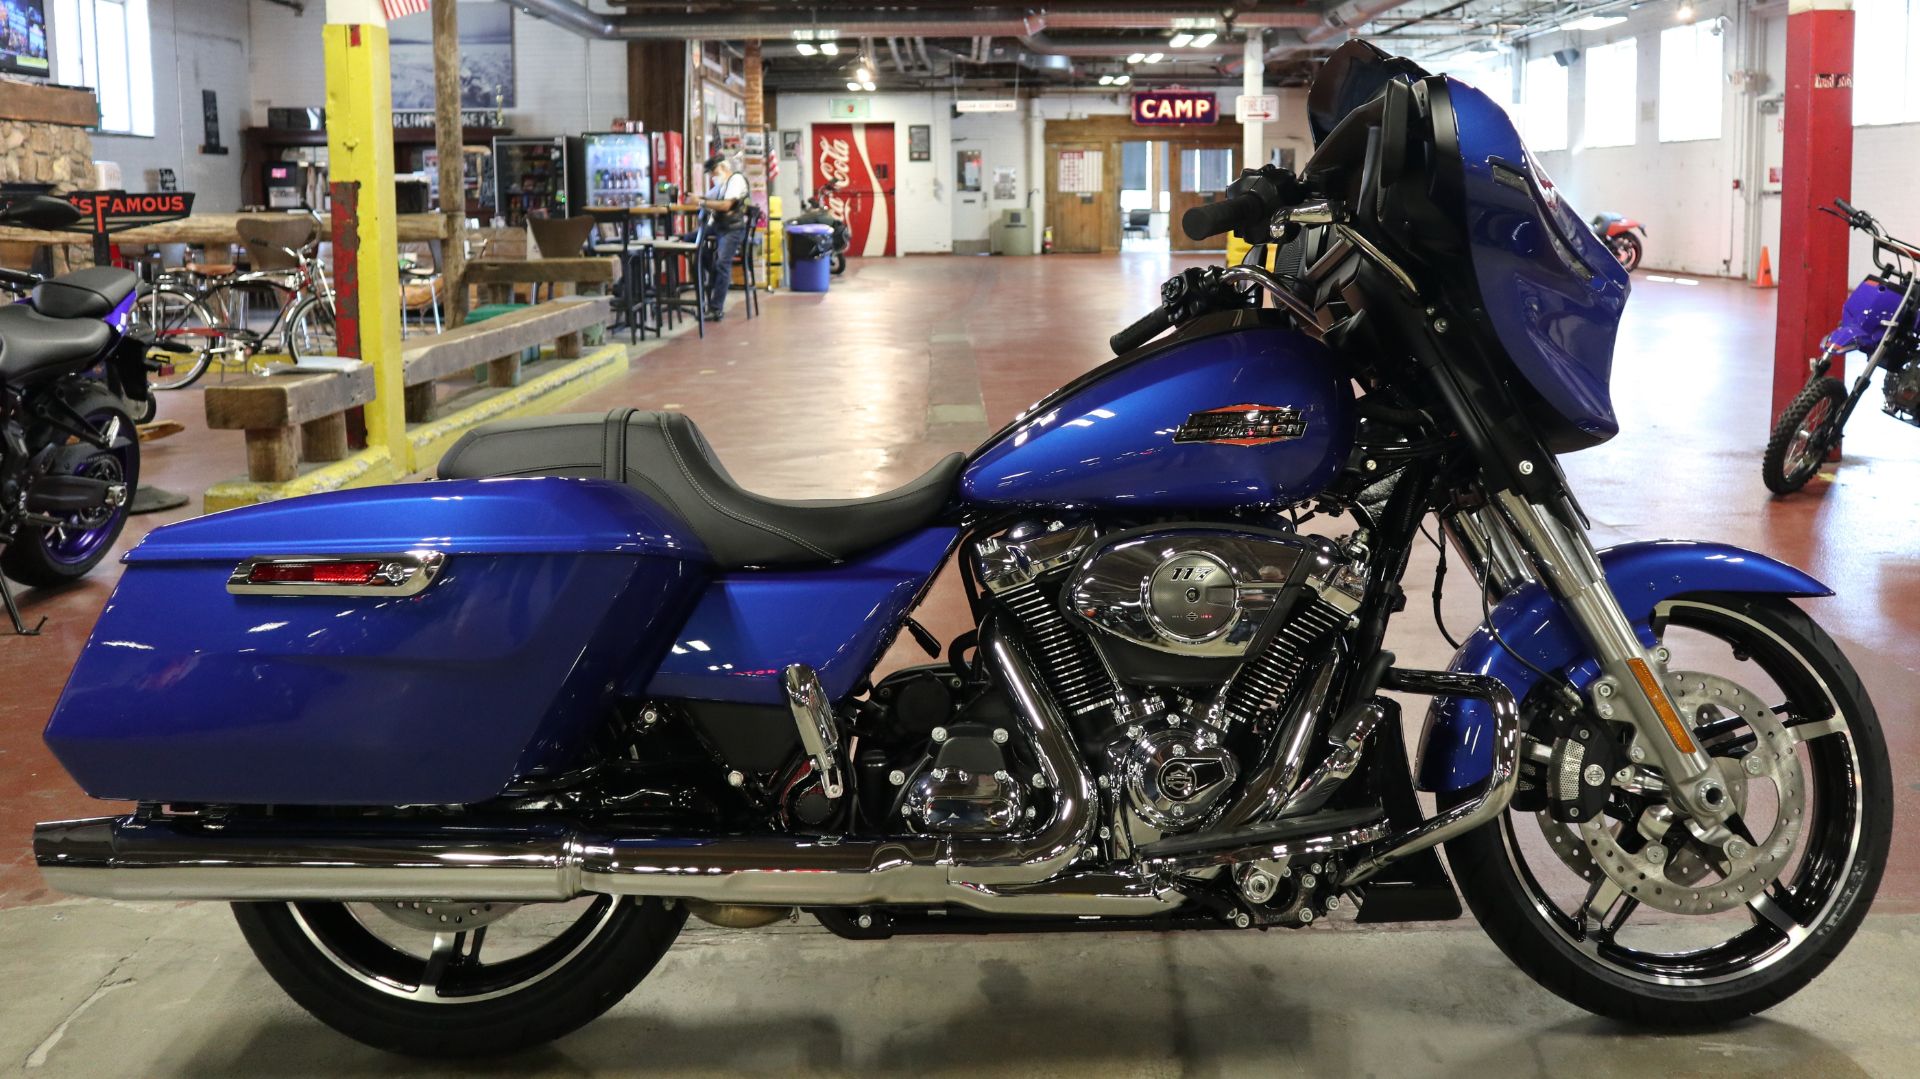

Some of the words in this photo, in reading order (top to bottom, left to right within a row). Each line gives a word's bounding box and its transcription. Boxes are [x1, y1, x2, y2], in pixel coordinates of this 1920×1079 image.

[1140, 99, 1211, 119] CAMP
[95, 195, 185, 233] FAMOUS
[1171, 566, 1217, 582] 117
